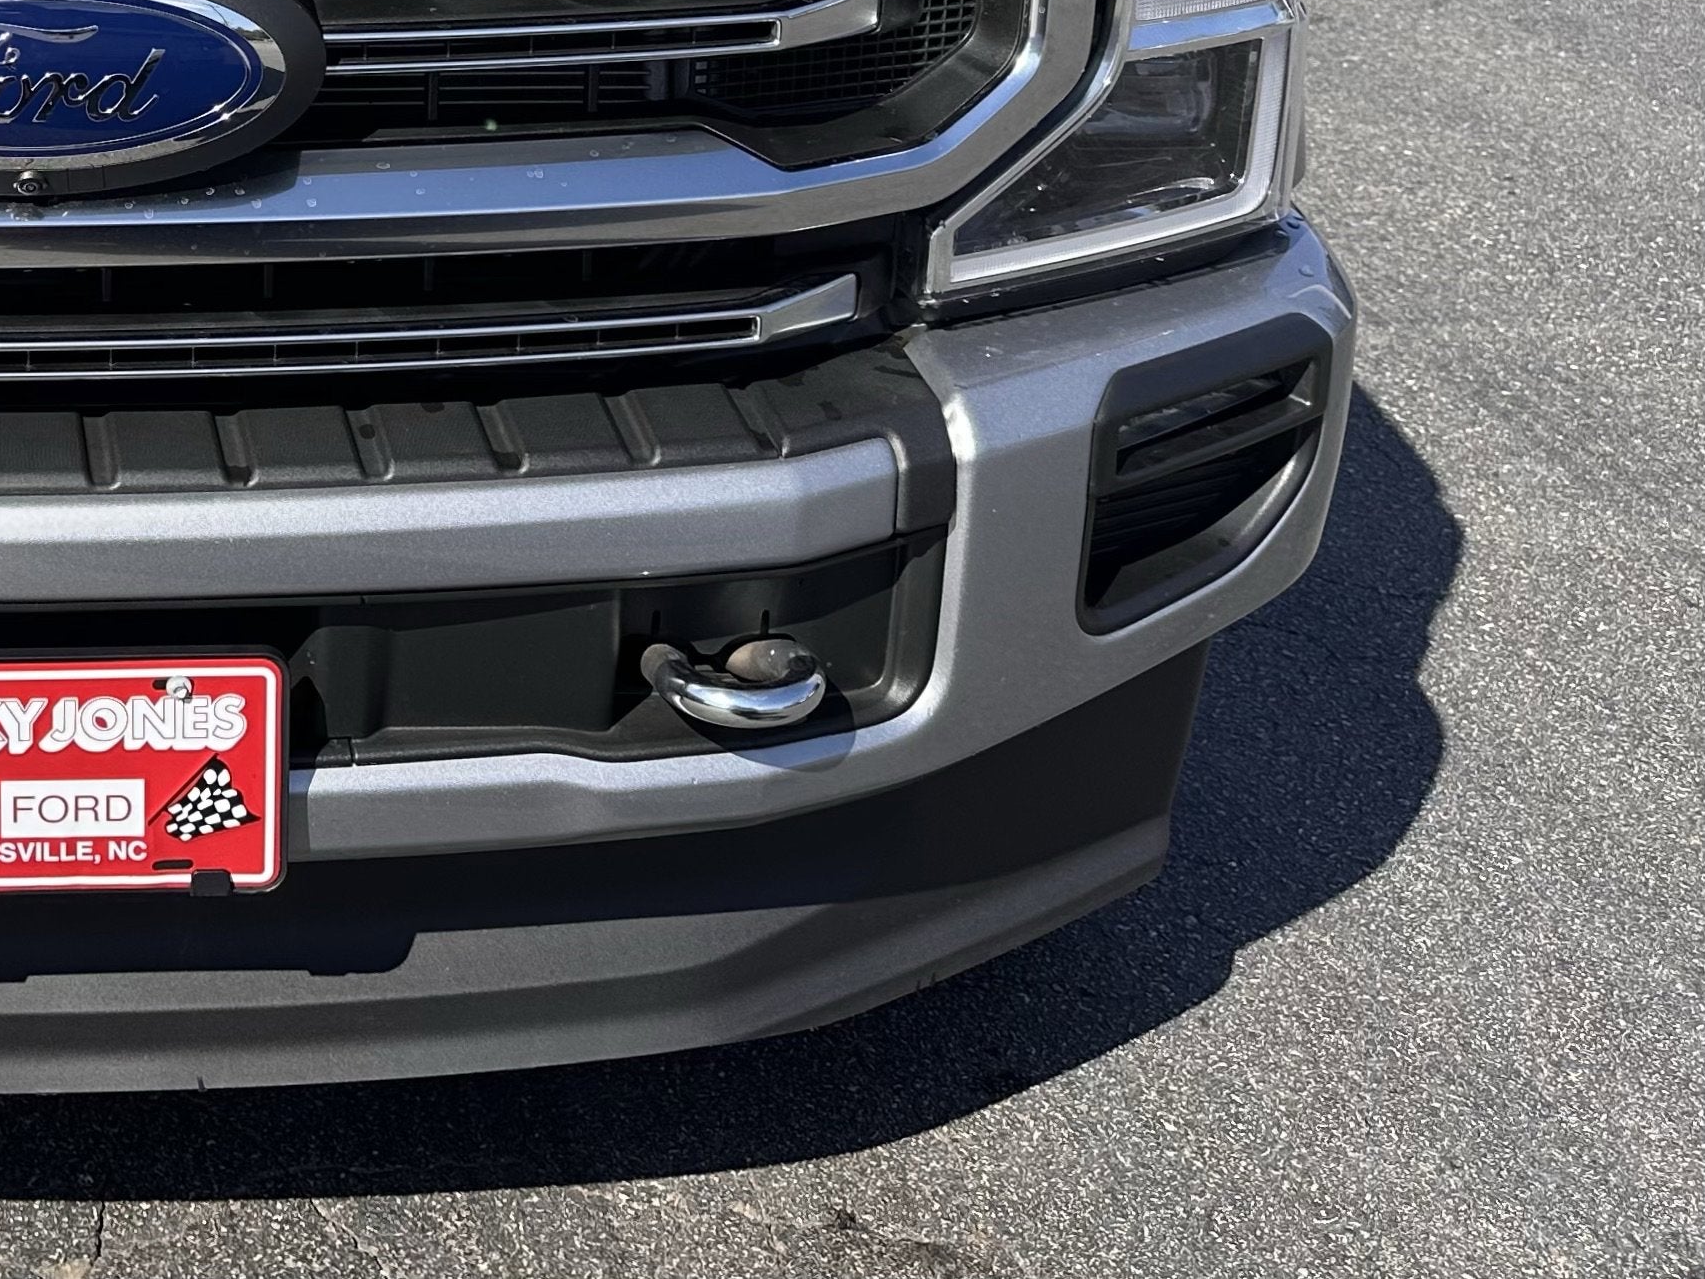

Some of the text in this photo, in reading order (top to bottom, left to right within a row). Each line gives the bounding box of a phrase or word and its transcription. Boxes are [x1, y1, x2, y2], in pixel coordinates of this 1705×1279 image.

[38, 694, 248, 753] JONES
[13, 794, 132, 824] FORD
[108, 840, 148, 862] NC
